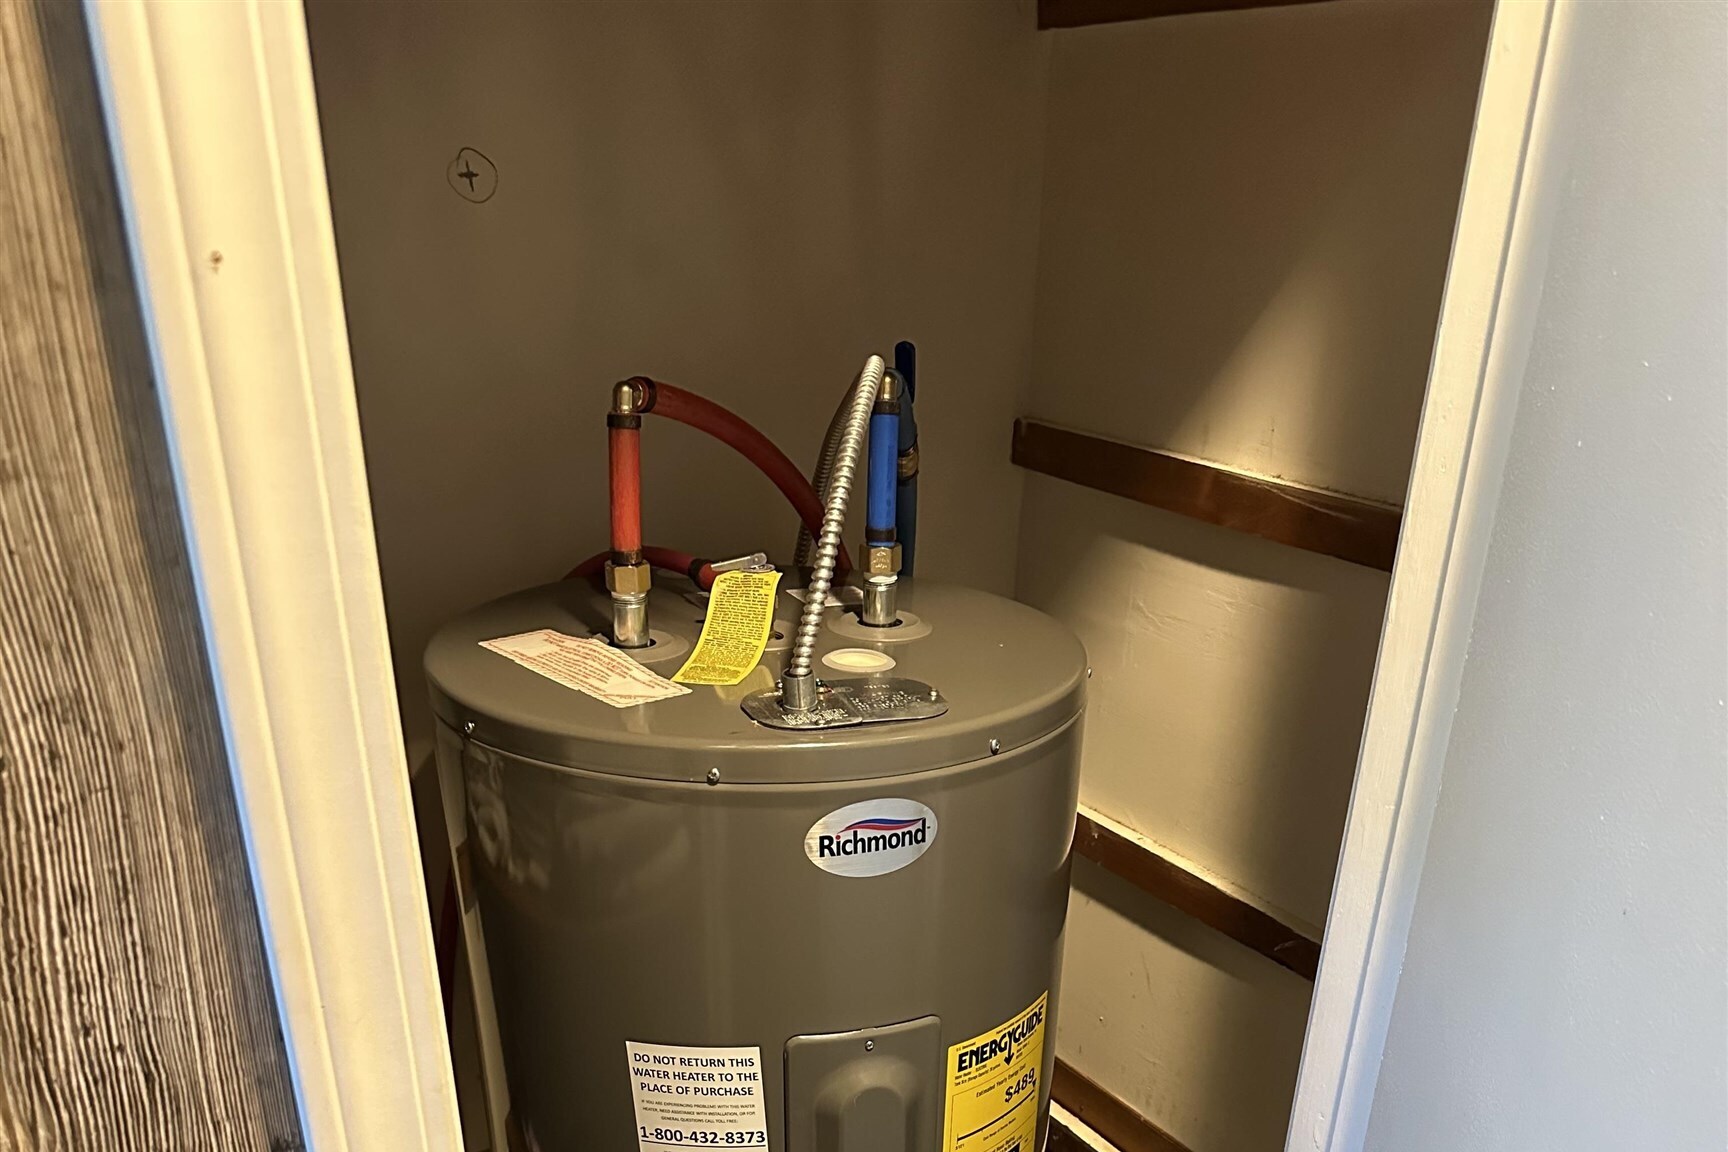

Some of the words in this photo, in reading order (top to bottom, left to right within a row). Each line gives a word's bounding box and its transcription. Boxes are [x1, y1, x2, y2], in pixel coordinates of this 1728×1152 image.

[819, 817, 926, 857] Richmond
[958, 1004, 1044, 1073] ENERGYGUIDE
[634, 1053, 650, 1063] DO
[653, 1055, 676, 1065] NOT
[679, 1058, 725, 1067] RETURN
[728, 1058, 754, 1067] THIS
[633, 1067, 670, 1079] WATER
[673, 1072, 715, 1082] HEATER
[718, 1073, 734, 1082] TO
[736, 1072, 759, 1081] THE
[640, 1082, 673, 1094] PLACE
[676, 1086, 690, 1095] OF
[694, 1087, 754, 1096] PURCHASE
[1005, 1067, 1035, 1103] $489
[640, 1126, 765, 1144] 1-800-432-8373
